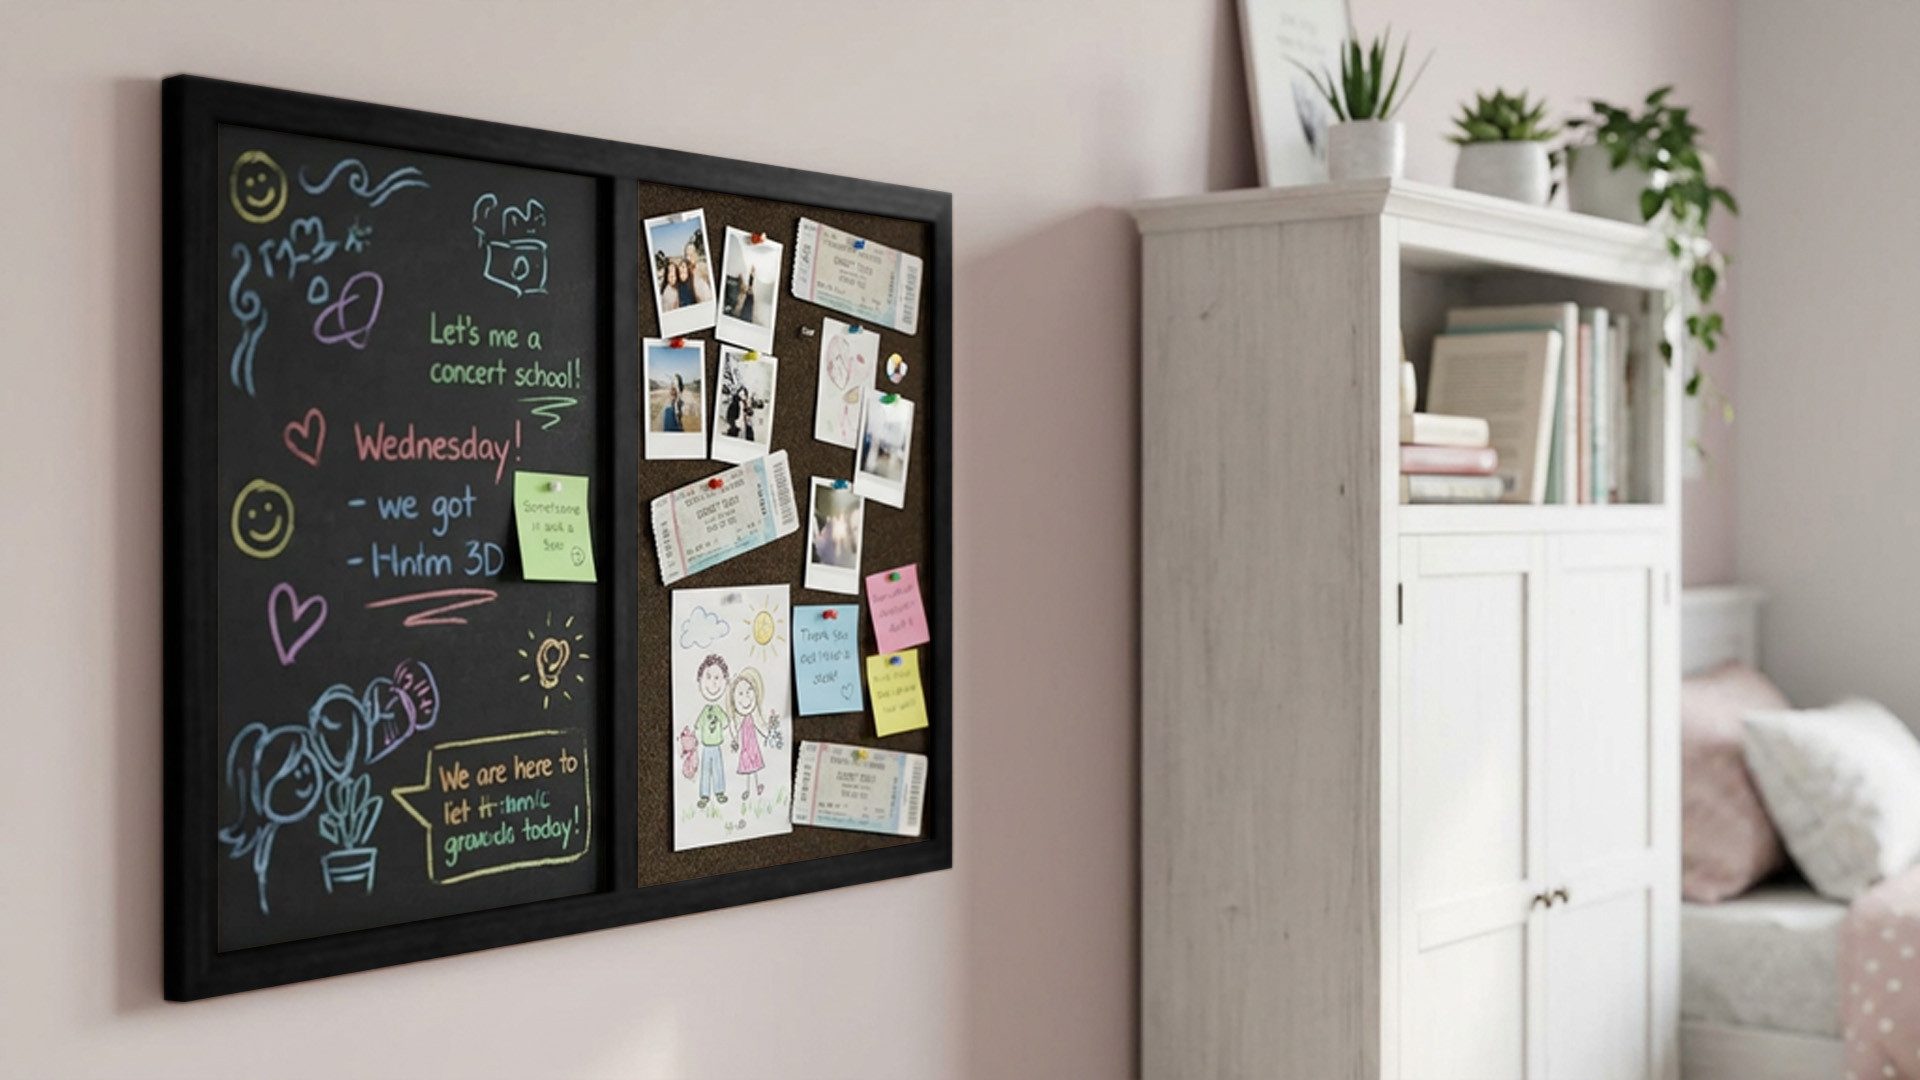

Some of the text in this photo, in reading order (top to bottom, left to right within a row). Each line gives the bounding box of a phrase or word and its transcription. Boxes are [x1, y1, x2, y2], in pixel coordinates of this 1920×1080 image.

[430, 311, 542, 350] Let's me a
[430, 357, 580, 389] concert school!
[354, 419, 521, 484] Wednesday!
[377, 495, 419, 519] we
[431, 484, 477, 537] got
[463, 539, 505, 576] 3D
[438, 747, 578, 793] We are here to
[522, 804, 580, 850] today!
